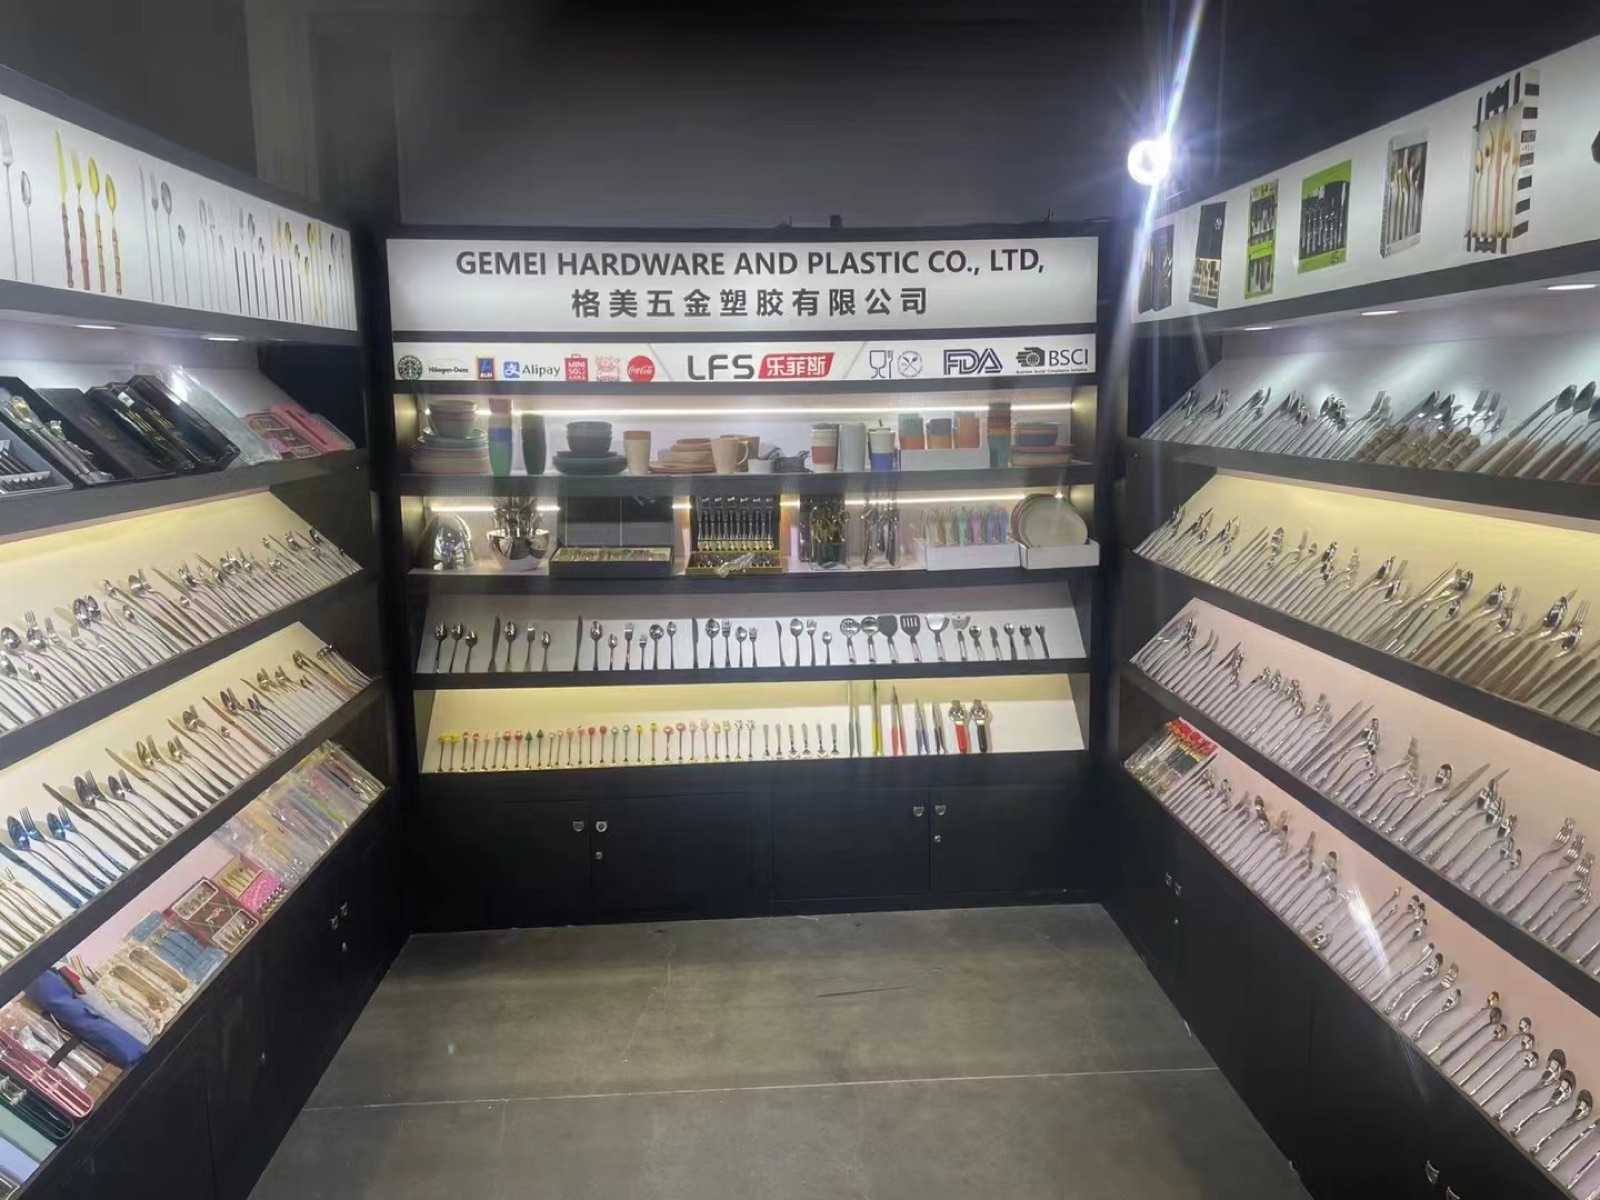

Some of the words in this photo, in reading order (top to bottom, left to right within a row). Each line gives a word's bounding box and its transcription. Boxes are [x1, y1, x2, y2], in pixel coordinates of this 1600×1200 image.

[456, 251, 546, 275] GEMEI
[557, 252, 725, 276] HARDWARE
[734, 251, 798, 275] AND
[808, 251, 919, 275] PLASTIC
[928, 249, 980, 275] CO.,
[571, 288, 926, 318] 格美五金塑胶有限公司
[522, 363, 560, 377] Alipay
[687, 354, 755, 380] LFS
[766, 355, 826, 377] 乐菲斯
[943, 348, 1003, 375] FDA
[1049, 348, 1088, 366] BSCI
